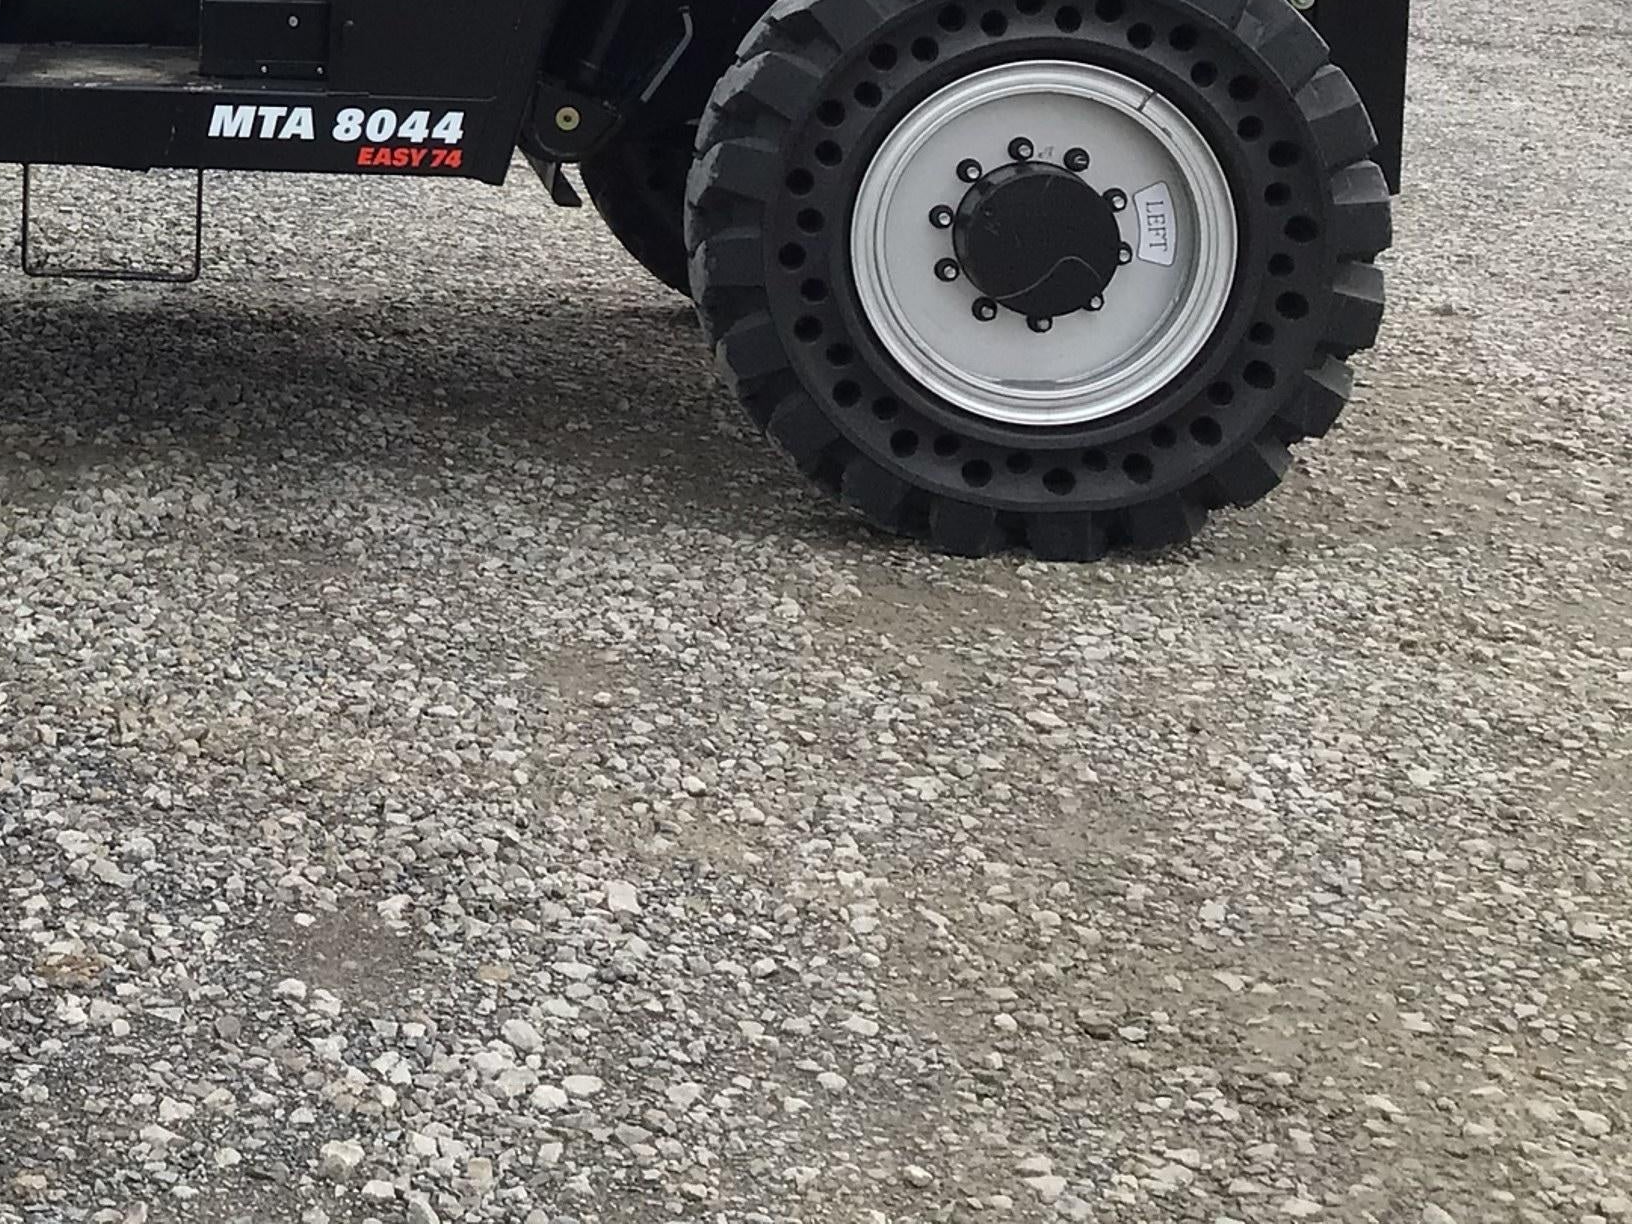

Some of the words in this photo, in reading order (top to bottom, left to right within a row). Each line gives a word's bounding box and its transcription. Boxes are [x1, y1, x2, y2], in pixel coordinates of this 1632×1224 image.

[208, 104, 316, 140] MTA
[332, 108, 465, 143] 8044
[356, 147, 428, 167] EASY
[429, 149, 463, 167] 74
[1146, 201, 1167, 251] LEFT
